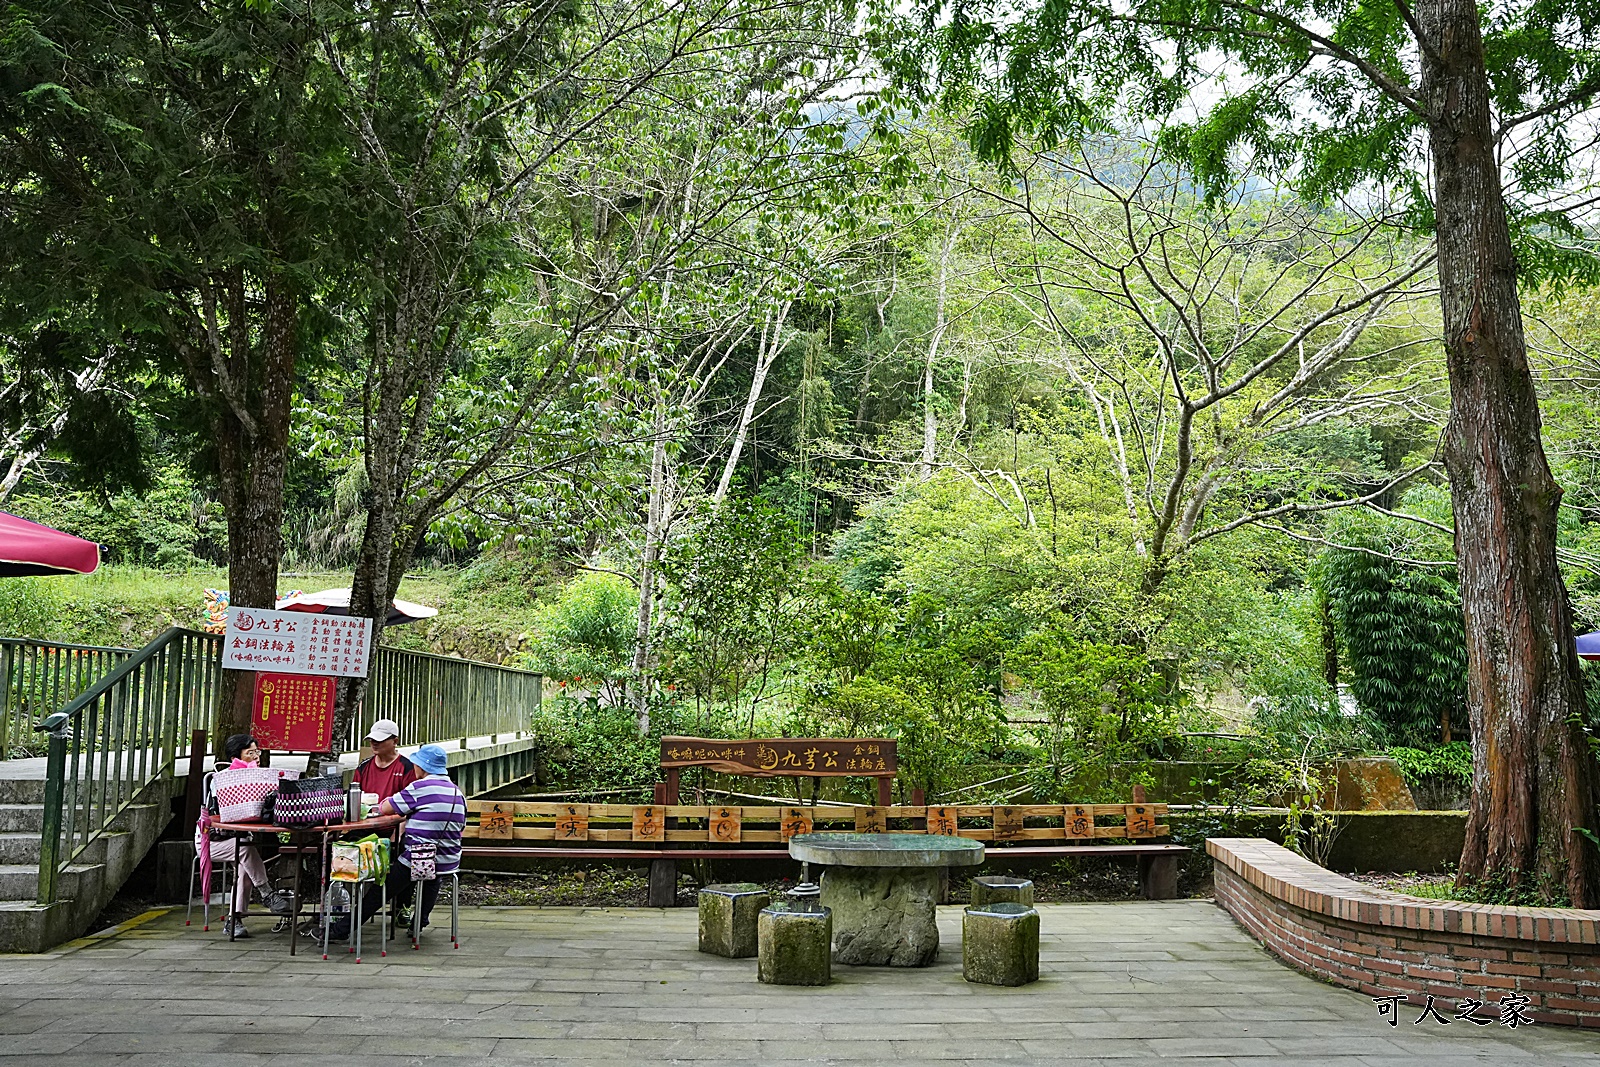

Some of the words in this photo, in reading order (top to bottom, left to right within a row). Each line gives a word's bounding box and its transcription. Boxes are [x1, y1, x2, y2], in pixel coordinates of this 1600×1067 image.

[256, 618, 298, 632] 九芎公
[231, 636, 295, 653] 金鋼法輪座
[853, 744, 880, 755] 金鋼
[781, 748, 840, 770] 九芎公
[846, 758, 886, 770] 法輪座
